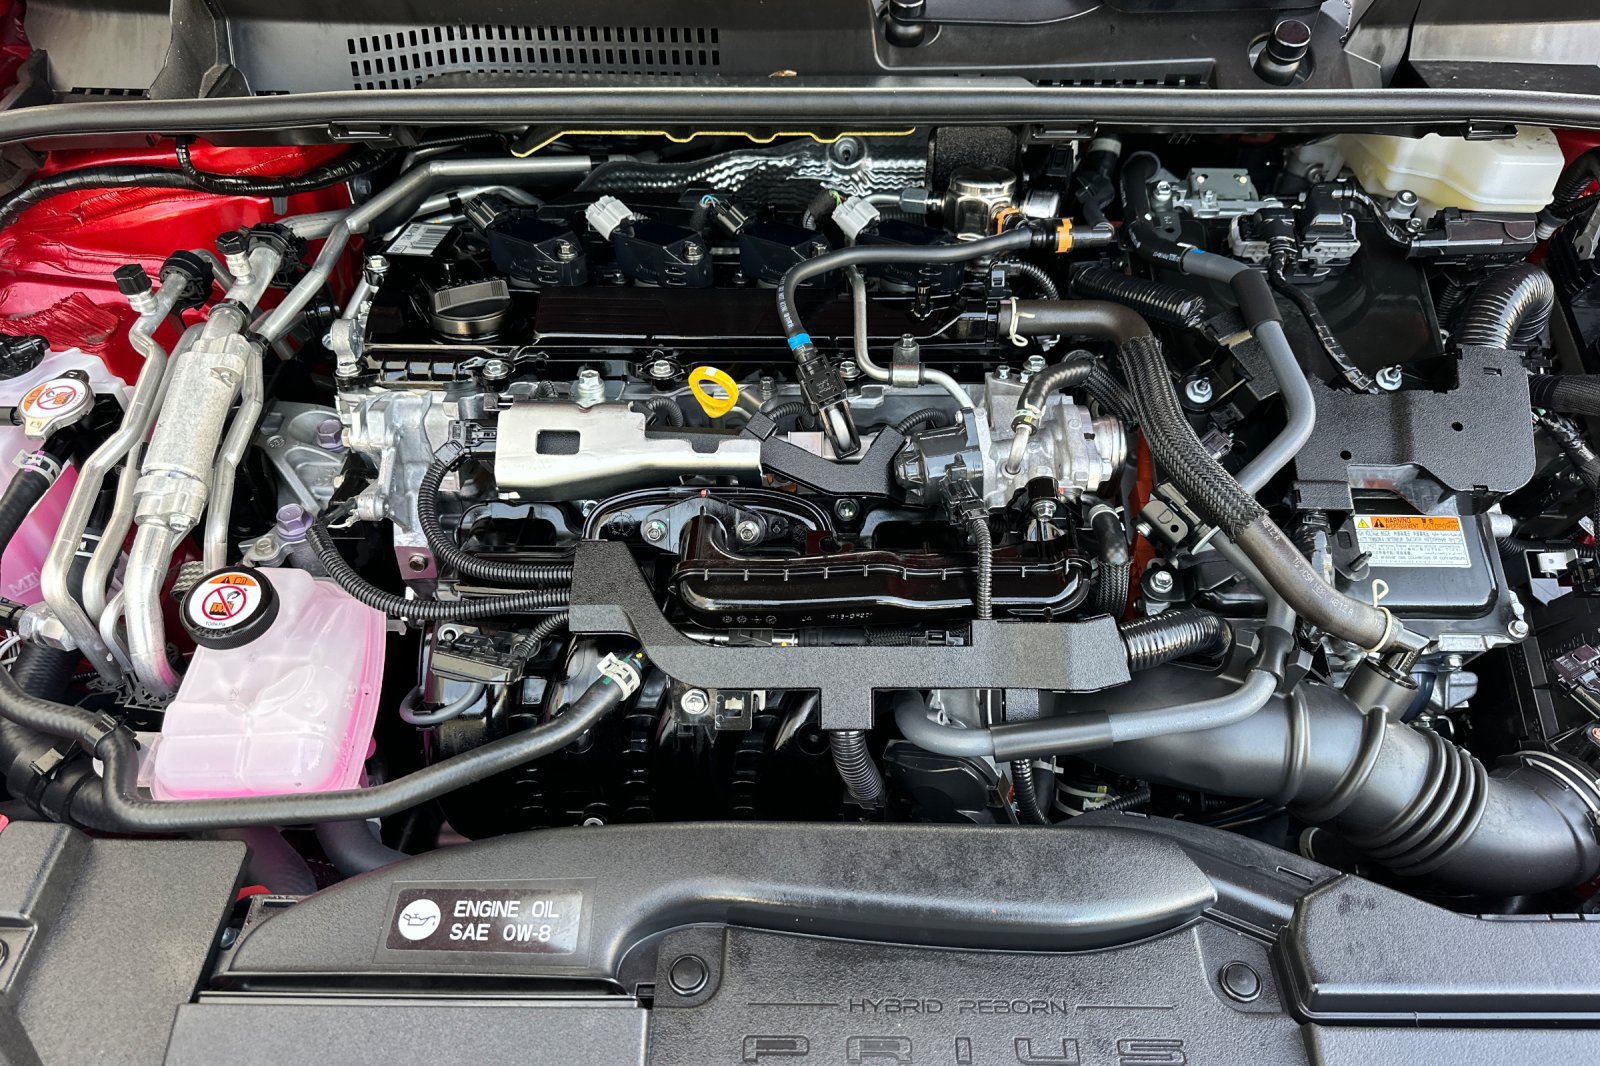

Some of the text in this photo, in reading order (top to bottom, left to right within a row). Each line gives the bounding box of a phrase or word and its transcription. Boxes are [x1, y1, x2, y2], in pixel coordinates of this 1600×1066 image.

[453, 900, 560, 918] ENGINE OIL
[449, 923, 552, 942] SAE 0W-8
[849, 998, 1067, 1016] HYBRID REBORN
[742, 1035, 1187, 1066] PRIUS
